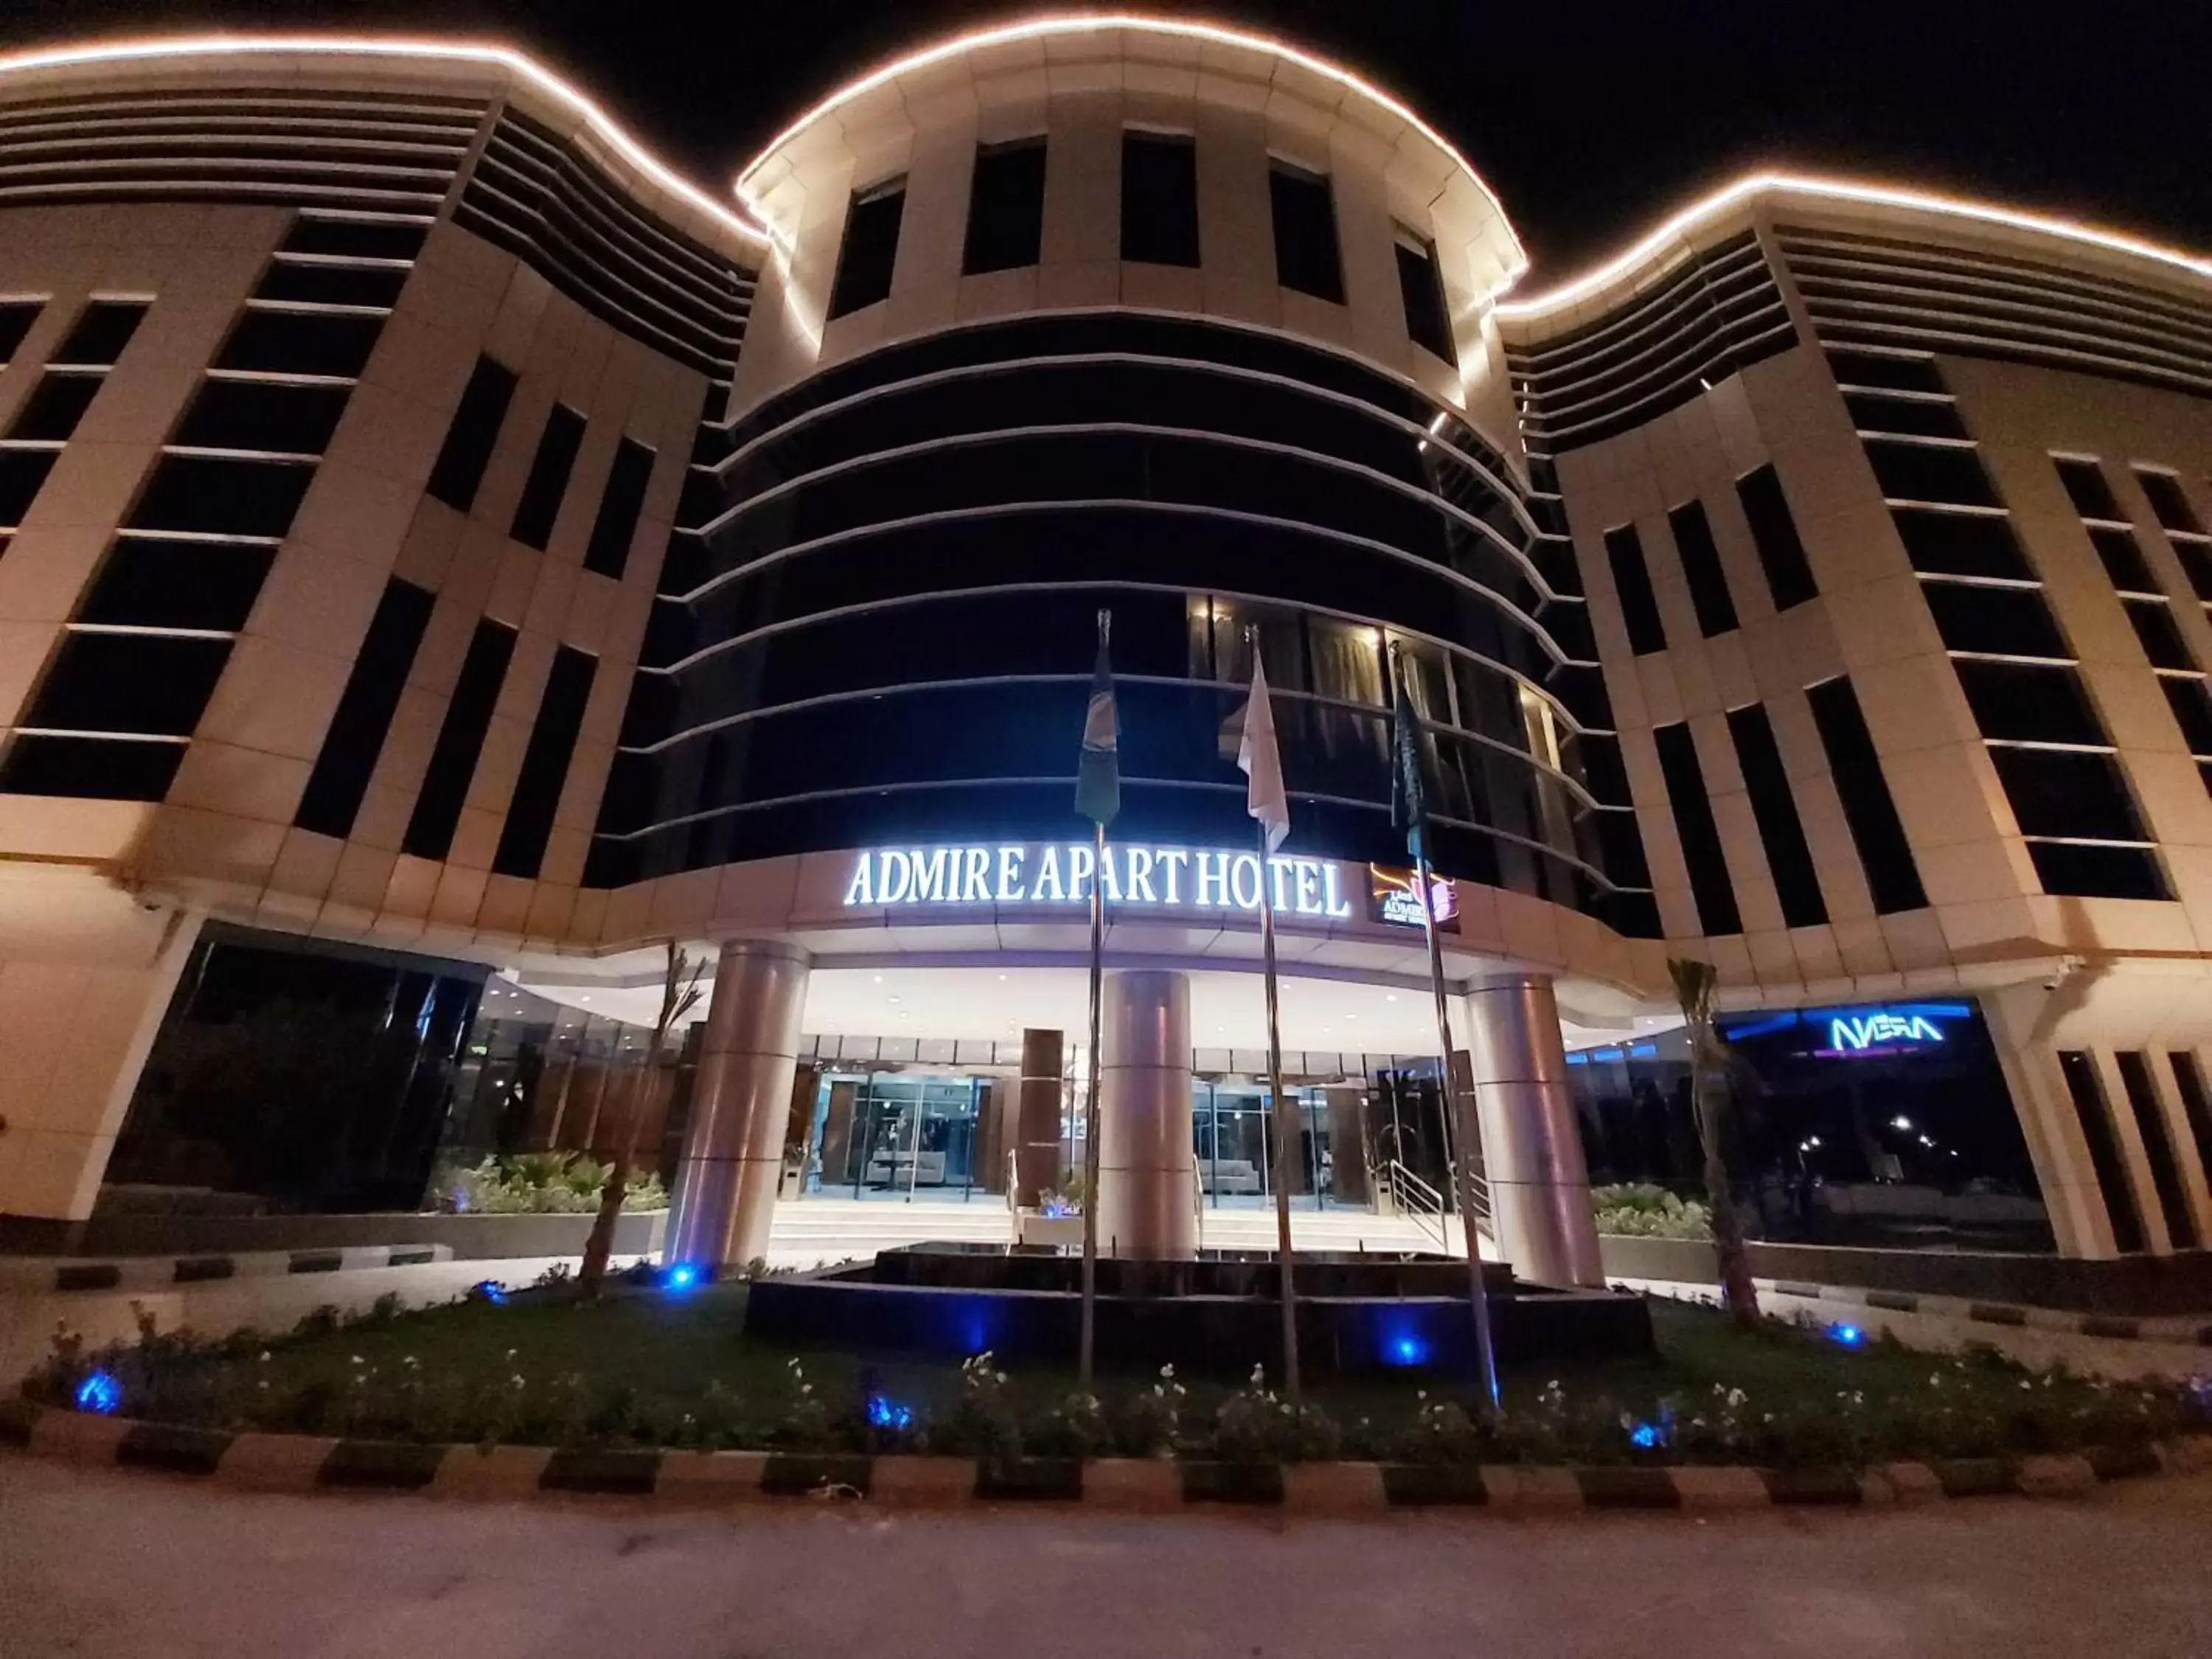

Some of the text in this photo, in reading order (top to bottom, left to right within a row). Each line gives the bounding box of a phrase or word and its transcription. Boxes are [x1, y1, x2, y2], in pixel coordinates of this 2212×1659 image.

[844, 846, 1352, 917] ADMIRE APART HOTEL
